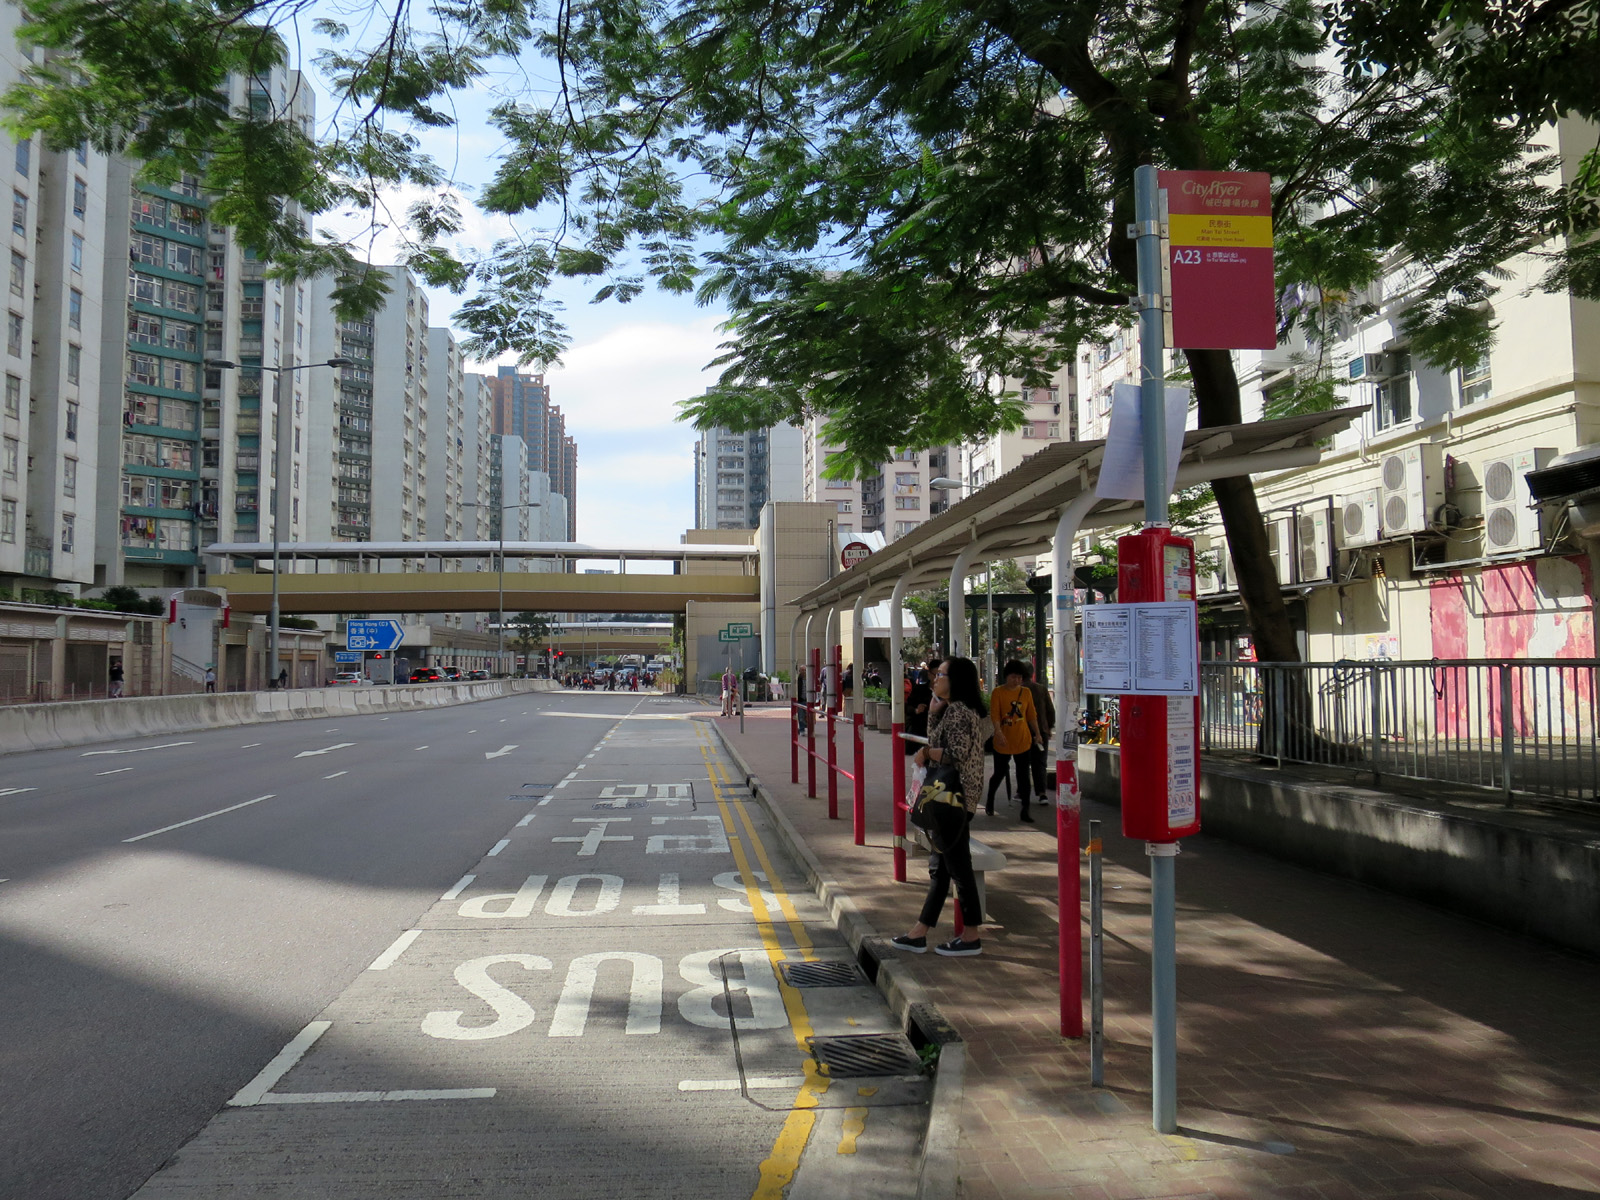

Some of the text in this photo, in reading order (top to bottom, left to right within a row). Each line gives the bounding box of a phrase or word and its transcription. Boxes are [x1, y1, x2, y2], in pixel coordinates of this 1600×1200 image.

[1174, 250, 1201, 264] A23
[551, 815, 731, 856] 巴士
[457, 871, 784, 919] STOP
[421, 946, 790, 1041] BUS
